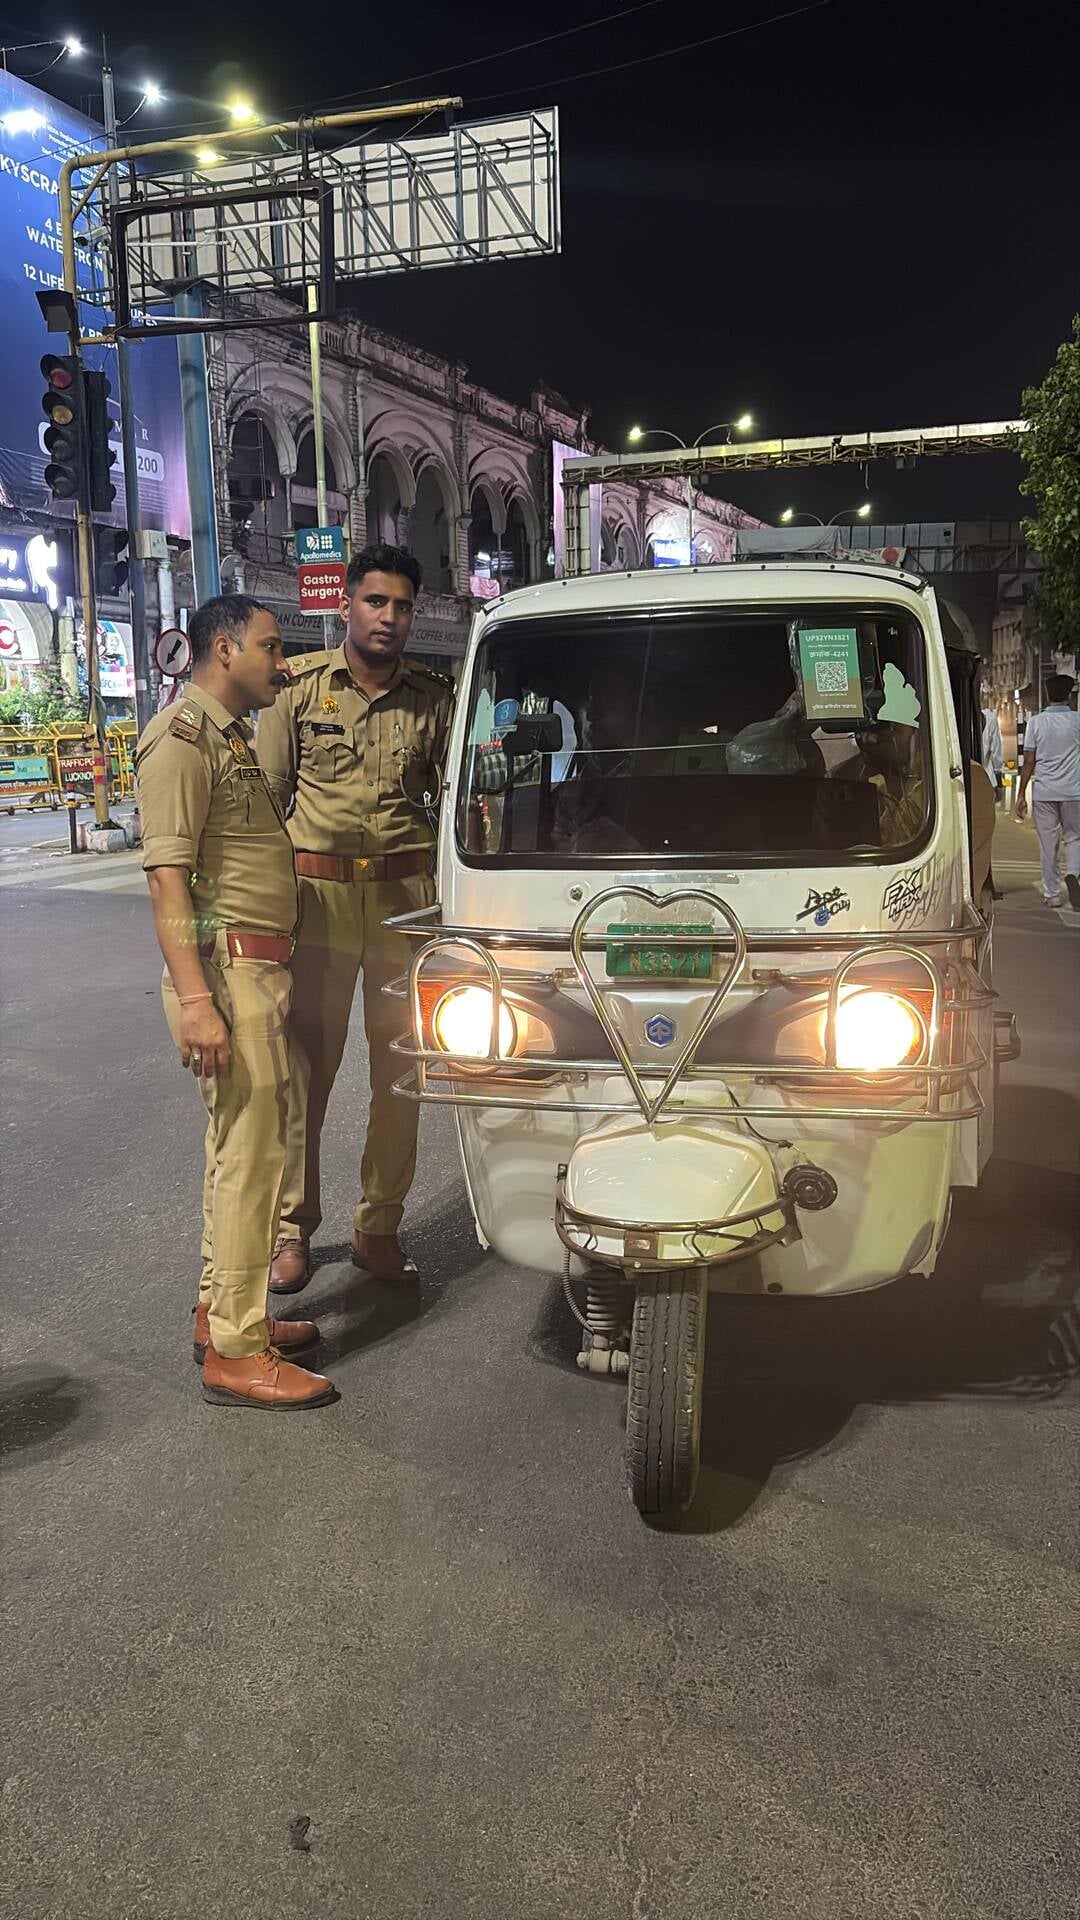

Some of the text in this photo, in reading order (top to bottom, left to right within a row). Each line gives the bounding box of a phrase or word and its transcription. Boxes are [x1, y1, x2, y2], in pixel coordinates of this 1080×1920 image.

[0, 153, 78, 204] KYSCRA
[23, 263, 37, 281] 12
[300, 551, 342, 563] Apollomedics
[303, 574, 341, 585] Gastro
[301, 587, 345, 600] Surgery
[292, 613, 323, 629] COFFEE
[882, 868, 922, 910] FX
[888, 885, 921, 919] MAX
